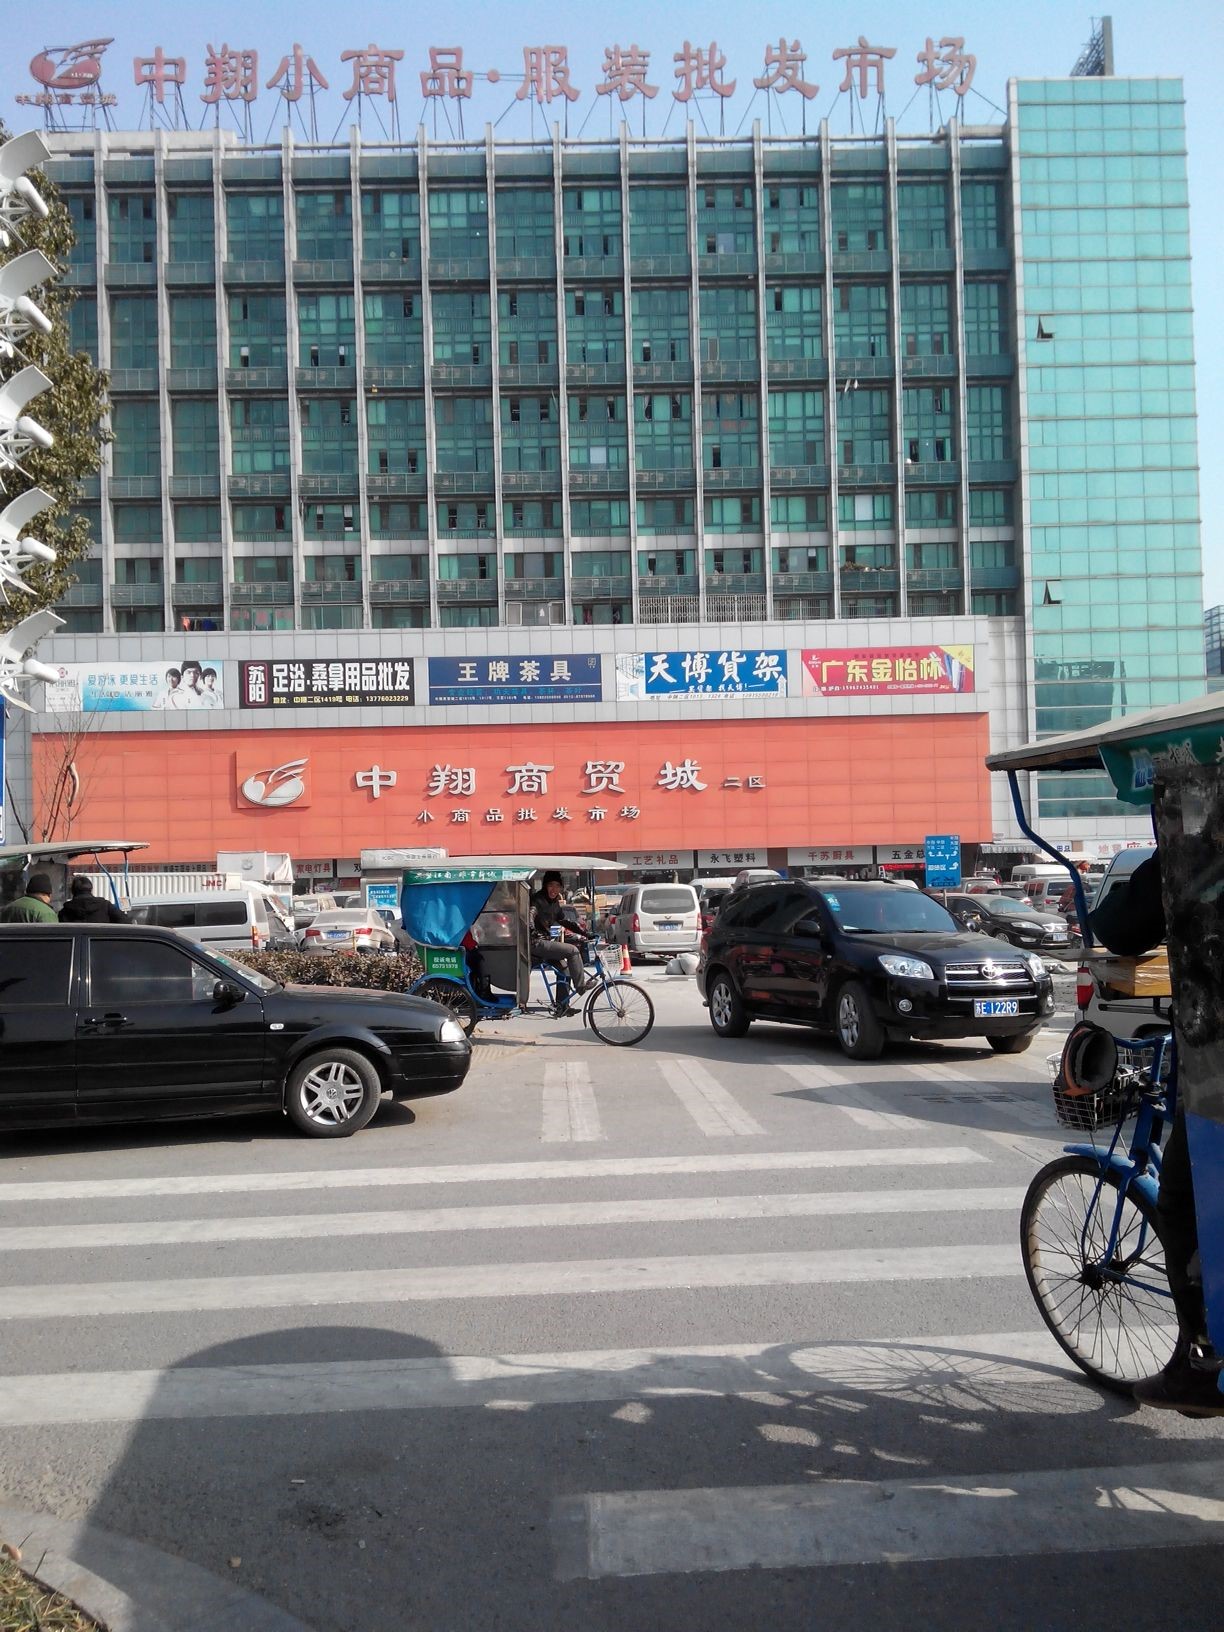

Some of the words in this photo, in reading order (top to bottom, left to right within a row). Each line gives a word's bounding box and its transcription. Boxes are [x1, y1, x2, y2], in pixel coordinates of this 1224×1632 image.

[132, 36, 977, 104] 中翔小商品·服装批发市场
[272, 661, 411, 693] 足浴·桑拿用品批发
[457, 659, 572, 683] 王牌茶具
[247, 665, 265, 703] 苏阳
[355, 758, 709, 799] 中翔商贸城
[723, 775, 767, 788] 二区
[416, 805, 641, 823] 小商品批发市场
[296, 863, 332, 874] 家电灯具
[632, 855, 679, 866] 工艺礼品
[710, 852, 756, 864] 永飞塑料
